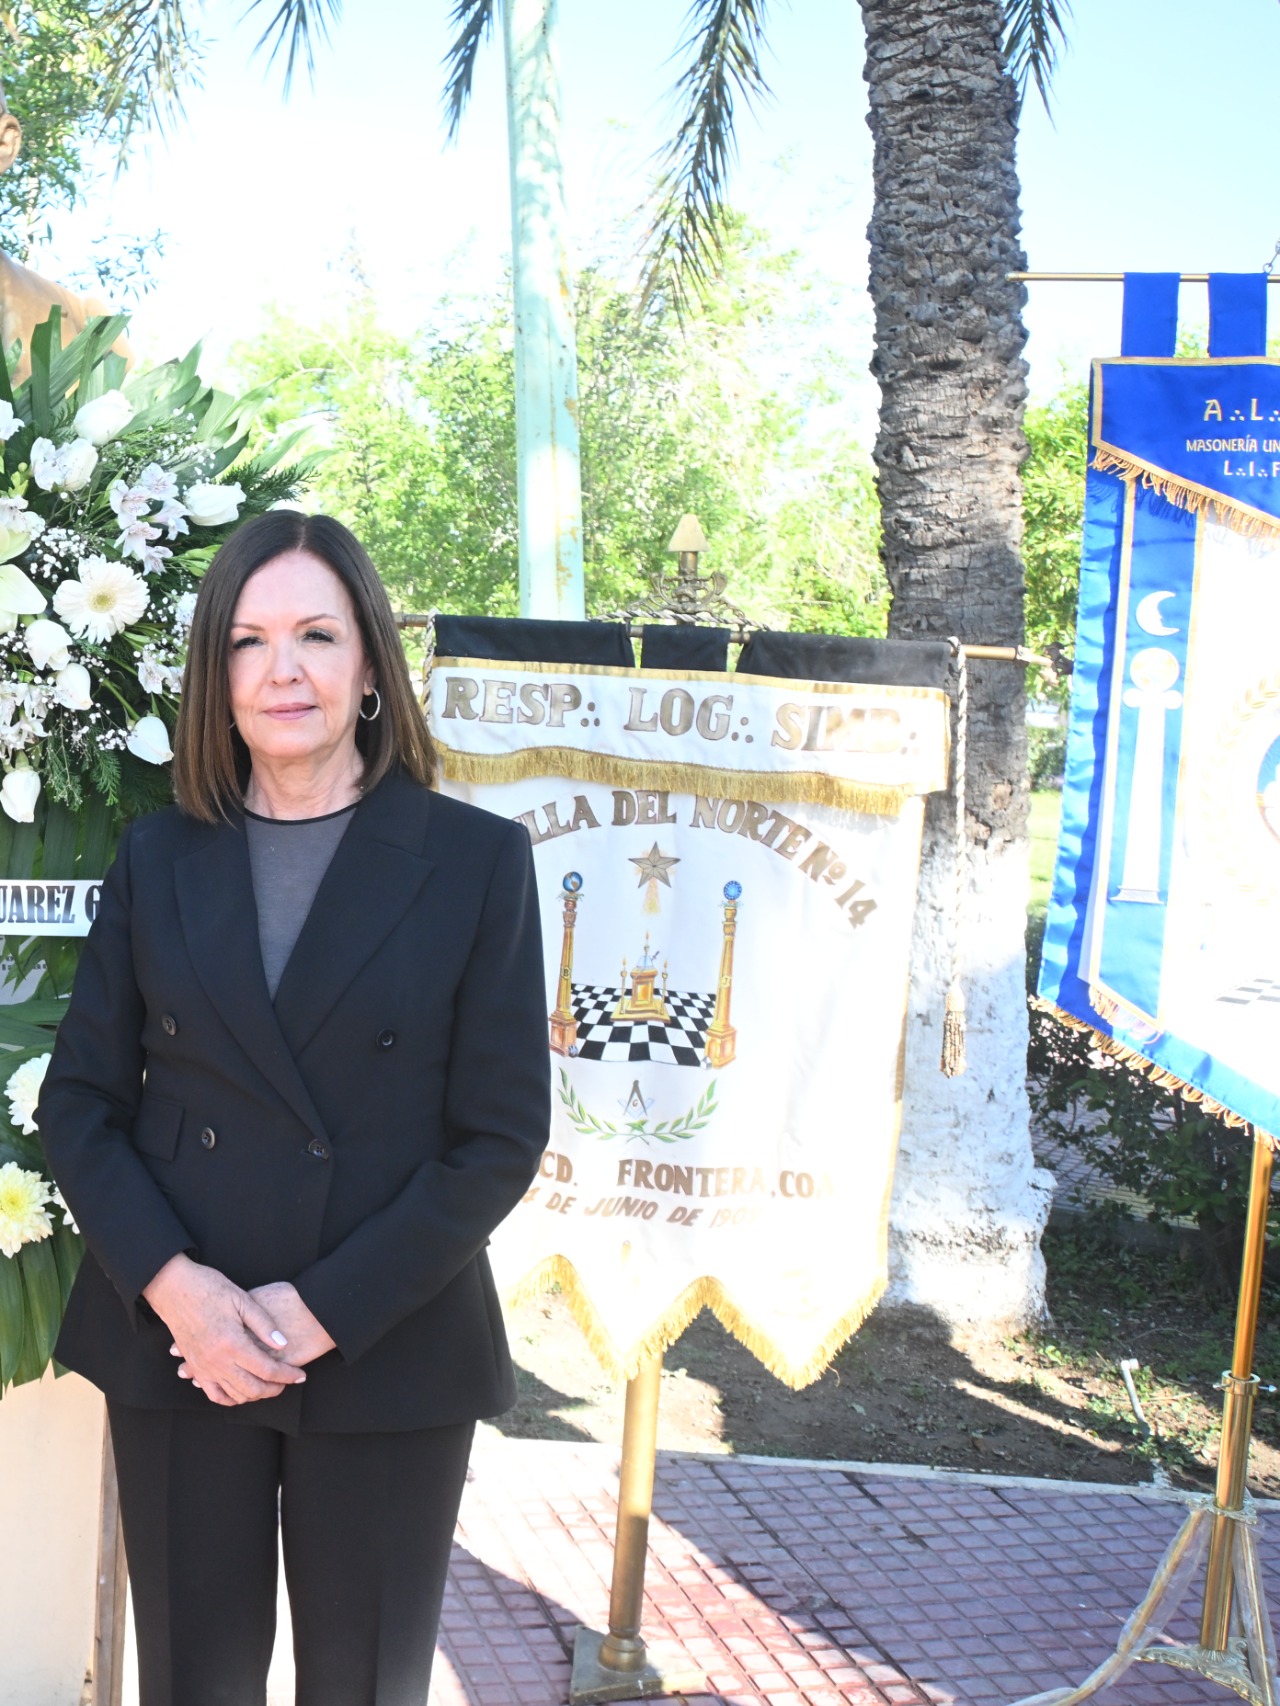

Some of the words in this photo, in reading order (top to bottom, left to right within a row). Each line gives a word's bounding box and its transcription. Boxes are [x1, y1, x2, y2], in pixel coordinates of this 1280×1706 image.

[1186, 434, 1258, 453] MASONERÍA
[611, 790, 677, 827] DEL
[689, 795, 812, 861] NORTE
[834, 879, 878, 929] 14
[545, 1192, 577, 1215] DE
[584, 1196, 658, 1220] JUNIO
[666, 1206, 704, 1227] DE
